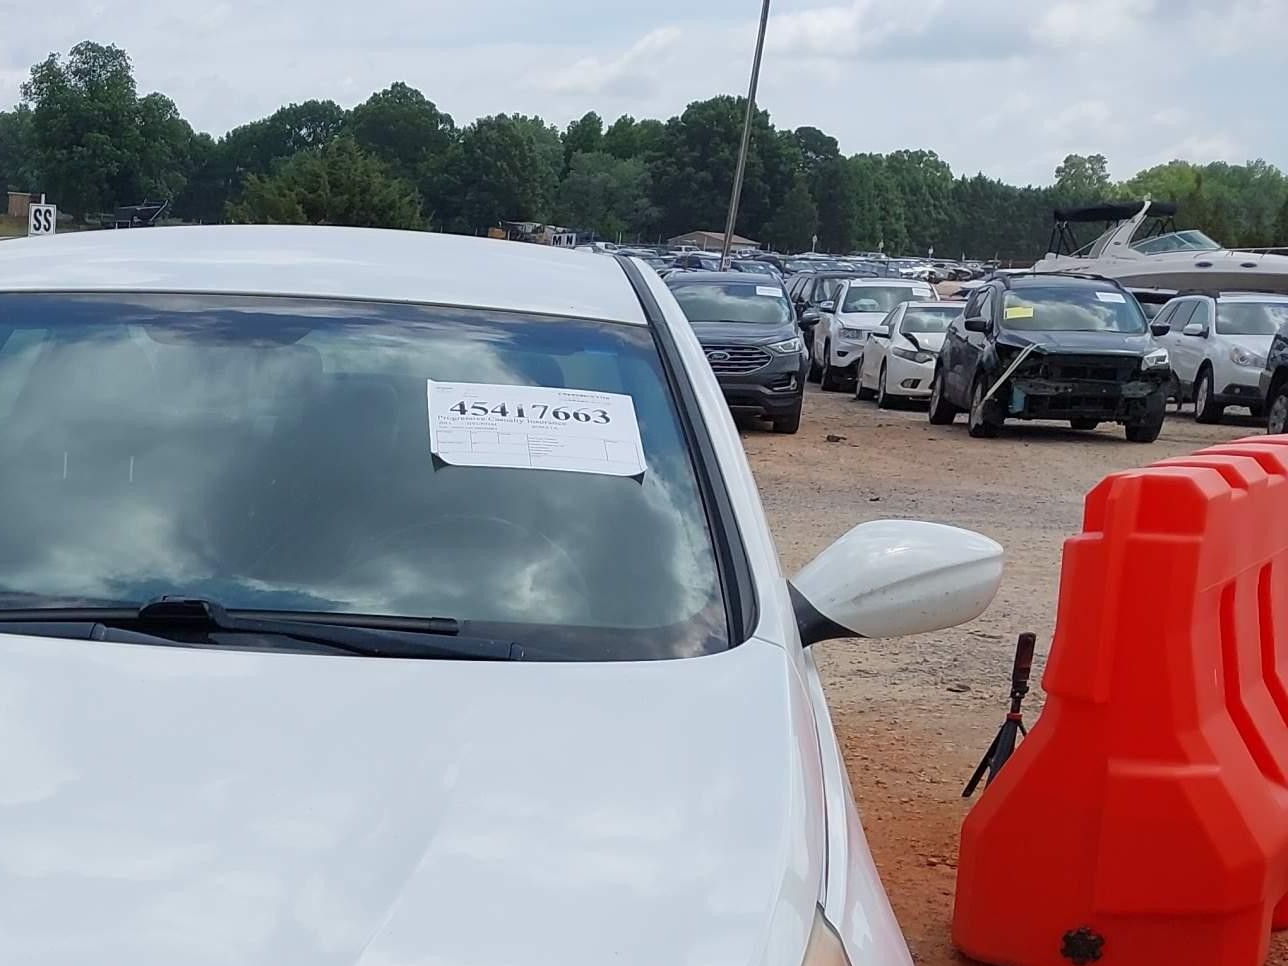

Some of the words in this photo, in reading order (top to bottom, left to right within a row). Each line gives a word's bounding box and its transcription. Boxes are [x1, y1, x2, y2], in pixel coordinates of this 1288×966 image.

[33, 208, 52, 232] SS
[450, 401, 611, 425] 45417663
[527, 418, 567, 426] Insurance
